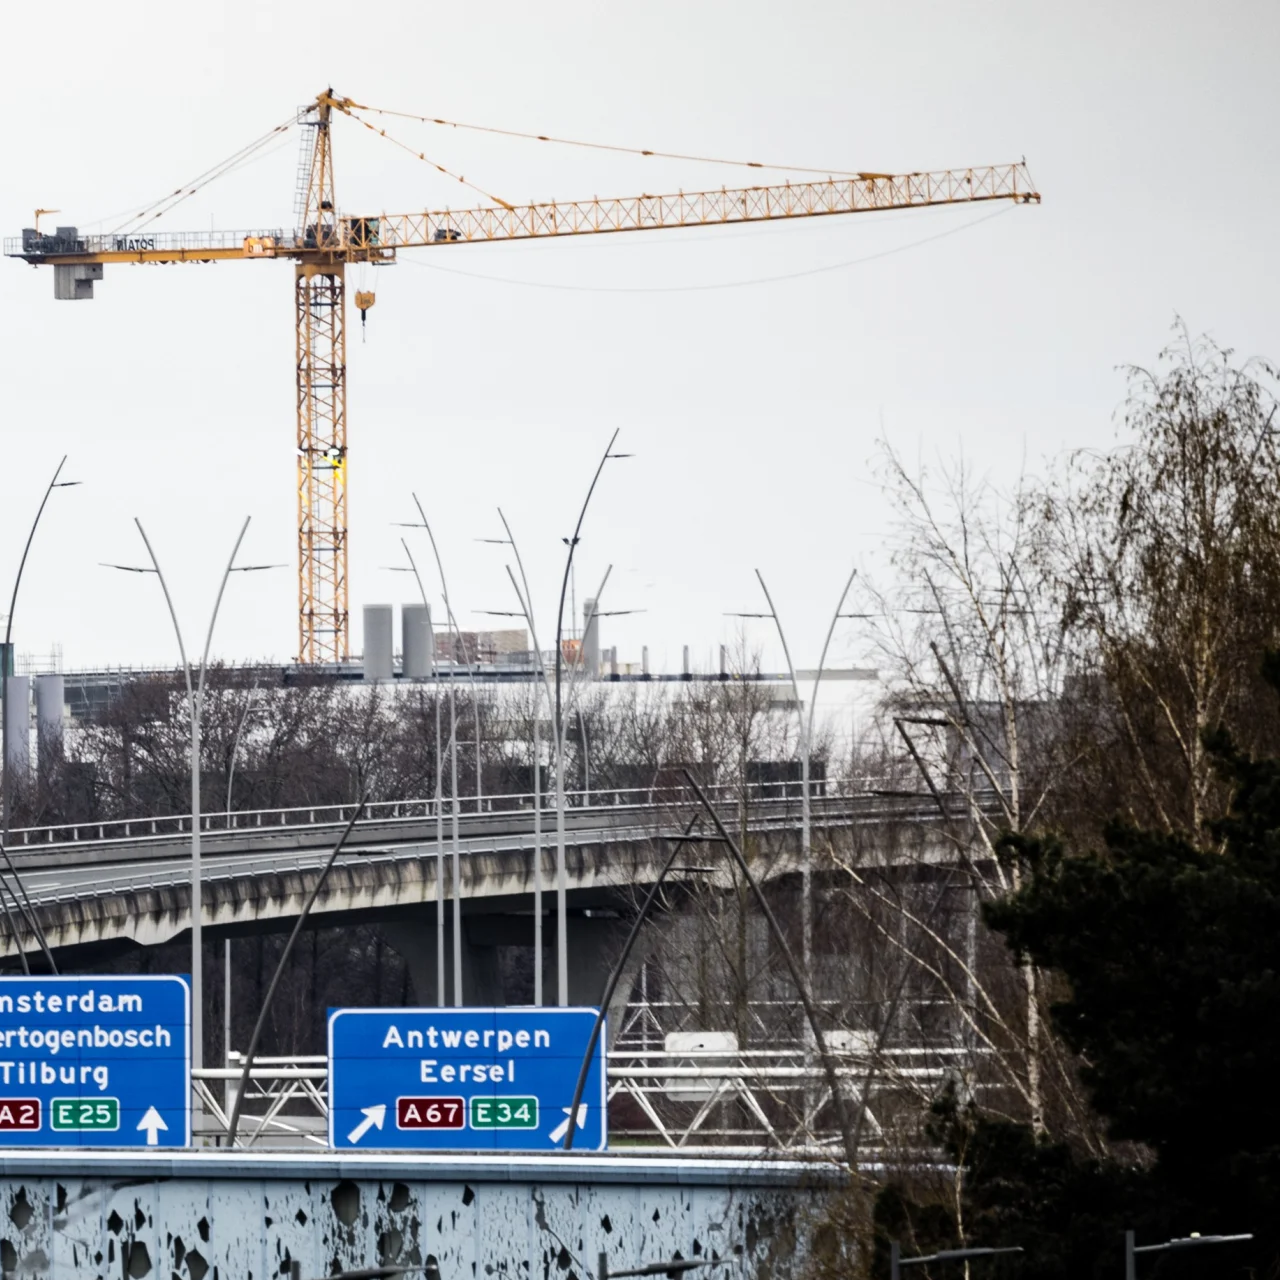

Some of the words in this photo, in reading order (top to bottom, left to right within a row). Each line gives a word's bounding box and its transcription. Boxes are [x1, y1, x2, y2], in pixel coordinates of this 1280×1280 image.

[382, 1025, 550, 1052] Antwerpen
[420, 1059, 514, 1083] Eersel
[58, 1105, 111, 1124] E25
[403, 1104, 459, 1123] A67
[477, 1103, 531, 1122] E34
